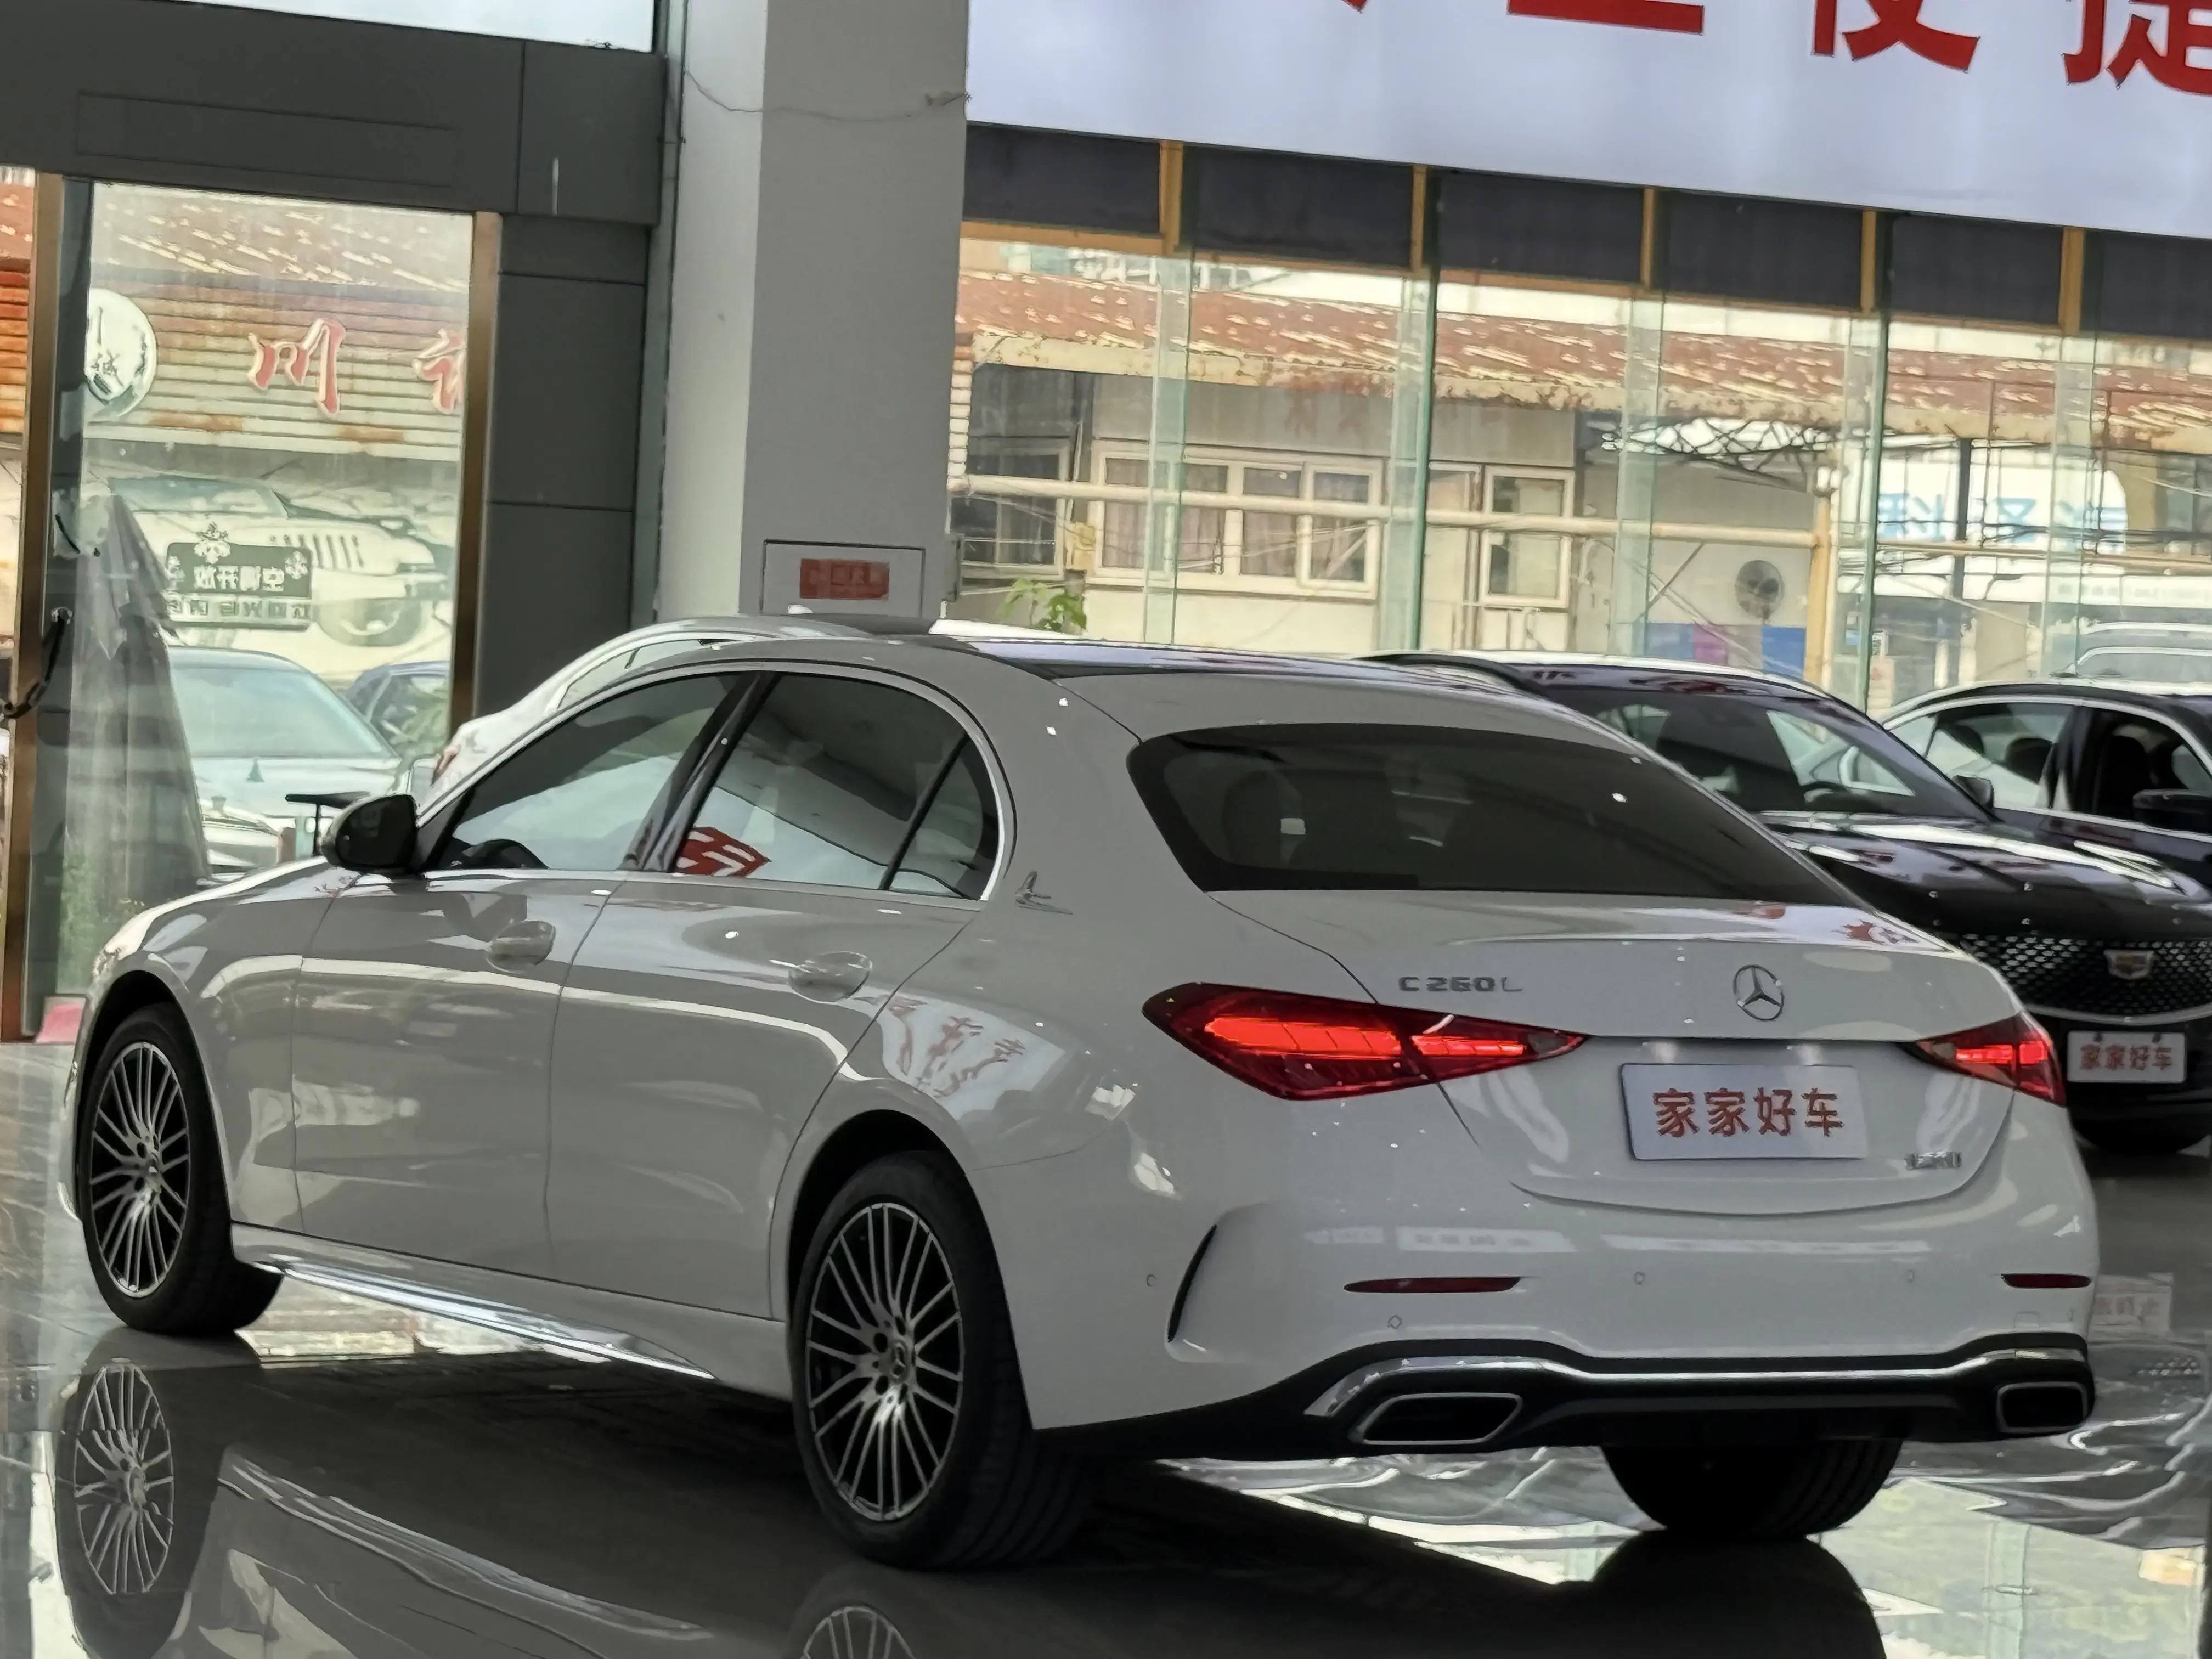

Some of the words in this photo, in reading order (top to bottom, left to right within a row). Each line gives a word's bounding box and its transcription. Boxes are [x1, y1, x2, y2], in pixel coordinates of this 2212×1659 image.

[2081, 1044, 2172, 1070] 家家好车
[1652, 1087, 1845, 1137] 家家好车
